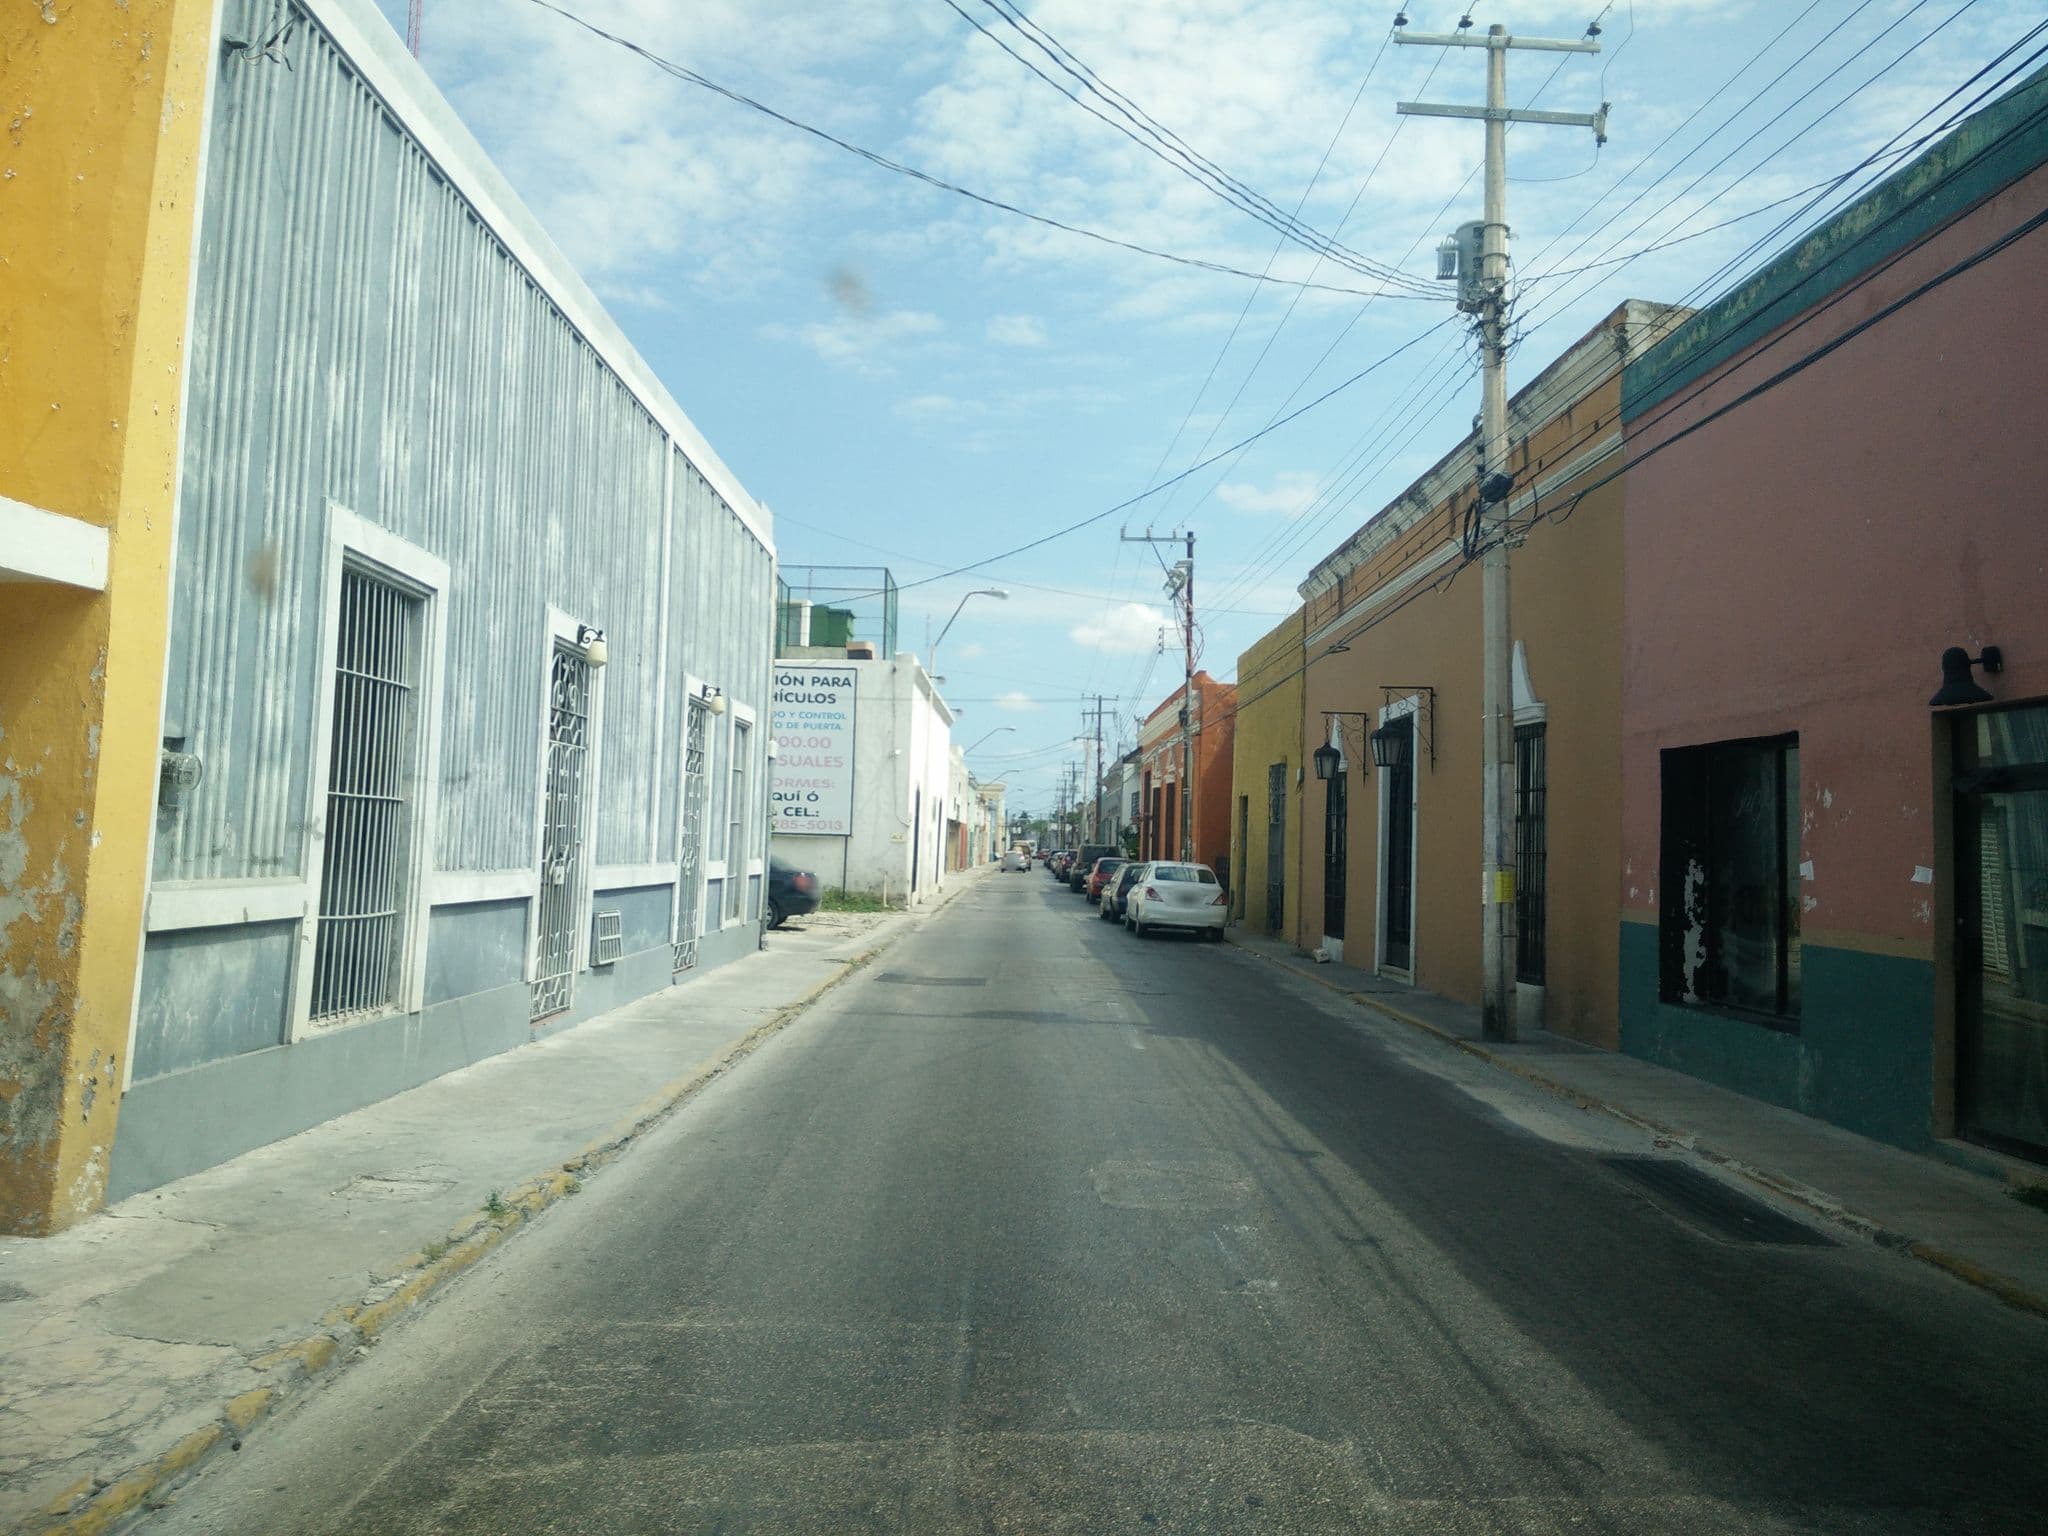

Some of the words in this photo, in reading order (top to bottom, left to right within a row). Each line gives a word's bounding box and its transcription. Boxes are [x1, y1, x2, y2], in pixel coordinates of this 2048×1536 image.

[811, 676, 852, 687] PARA
[798, 711, 847, 720] CONTROL
[786, 721, 799, 729] DE
[770, 736, 832, 749] 00.00
[775, 754, 844, 768] SUALES
[806, 790, 819, 802] Ó
